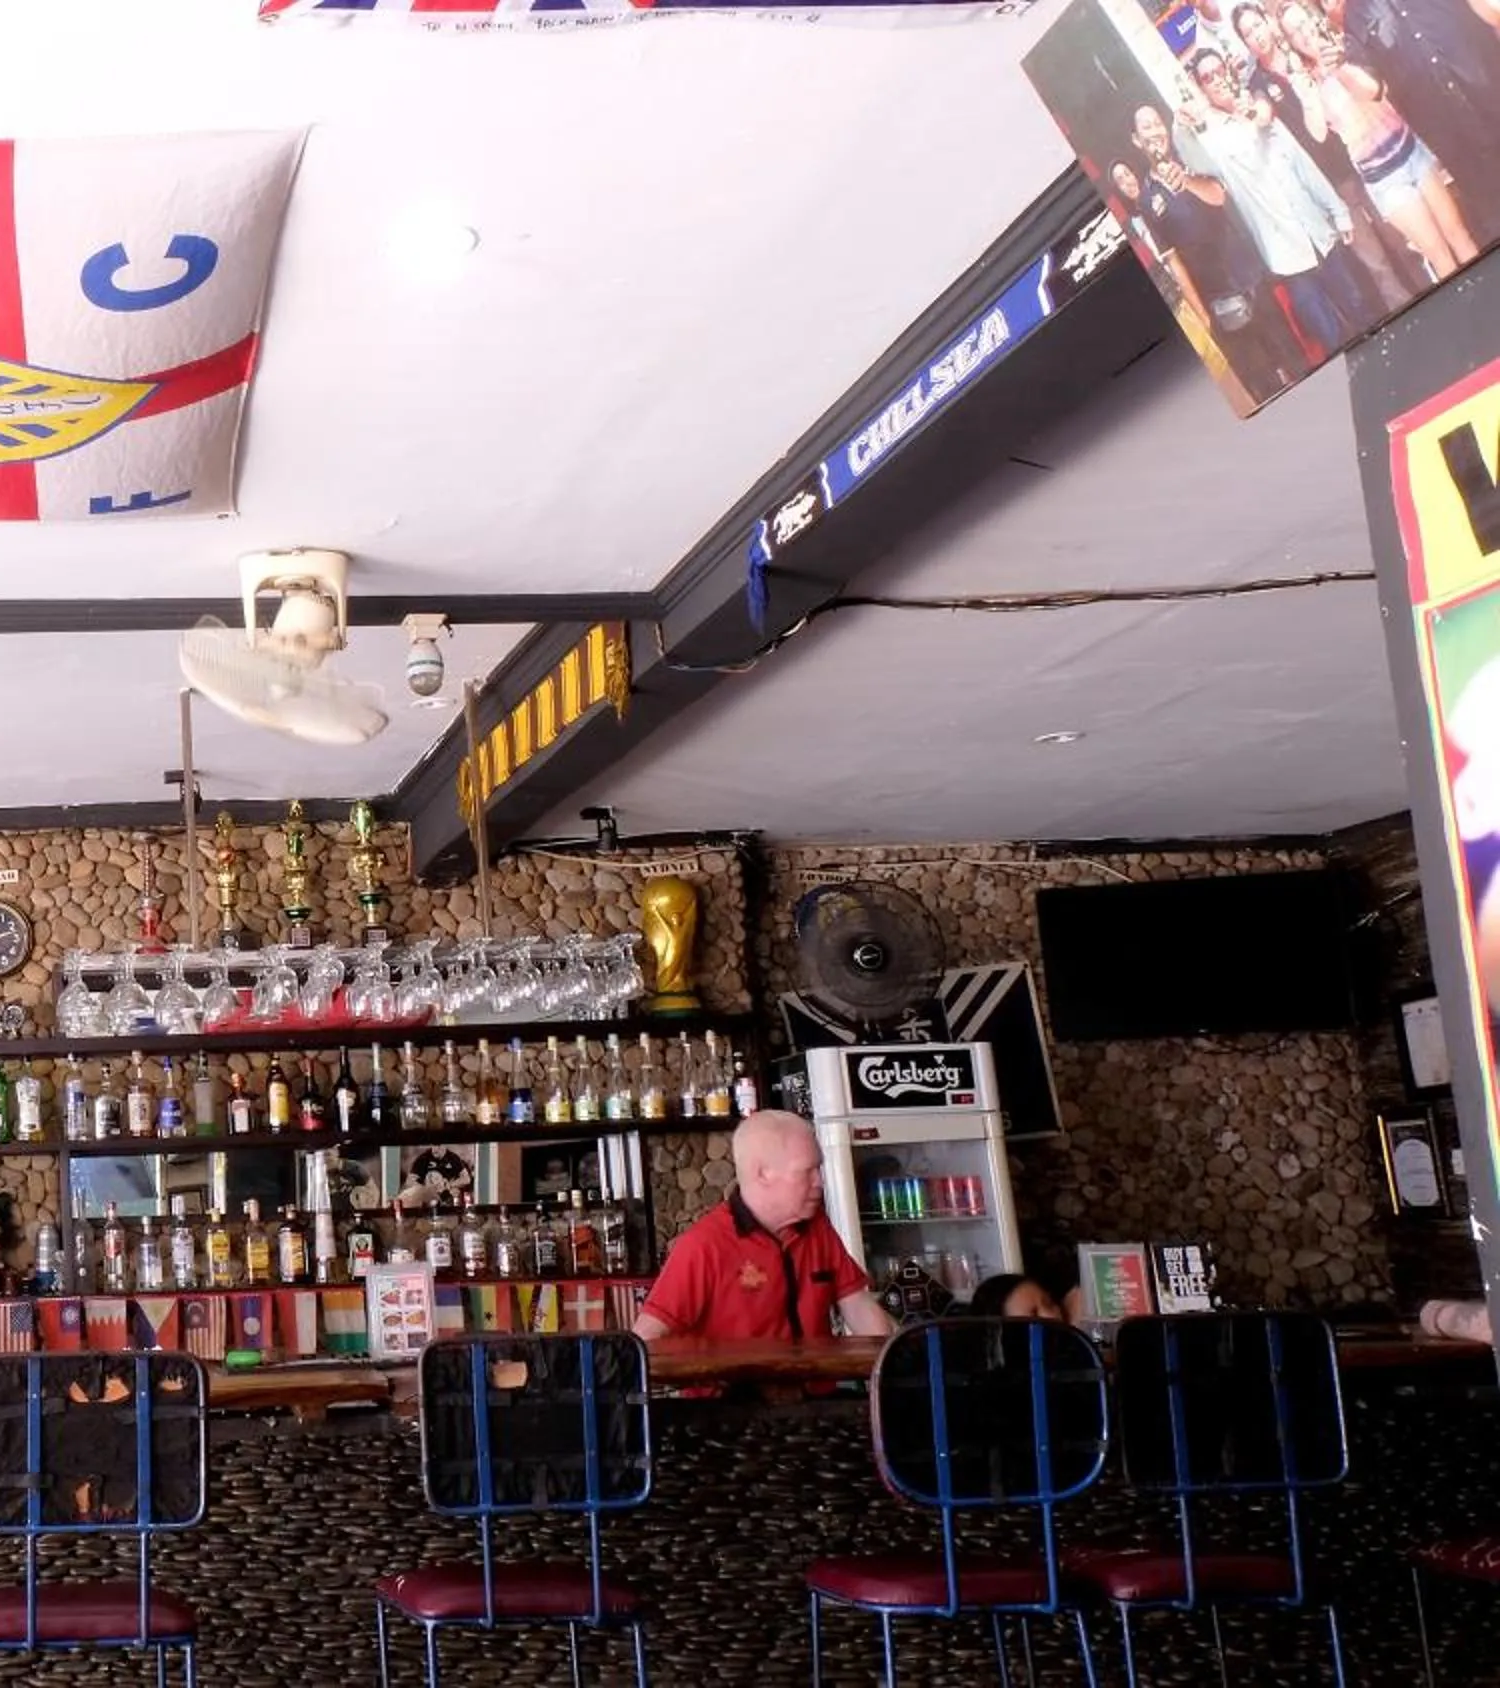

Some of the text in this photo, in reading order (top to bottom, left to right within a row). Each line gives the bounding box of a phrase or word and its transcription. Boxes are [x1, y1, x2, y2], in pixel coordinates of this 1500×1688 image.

[80, 234, 219, 312] C
[846, 307, 1012, 478] CHELSEA
[643, 862, 696, 874] SYDNEY
[857, 1054, 961, 1093] Carlsberg
[1169, 1273, 1210, 1297] FREE
